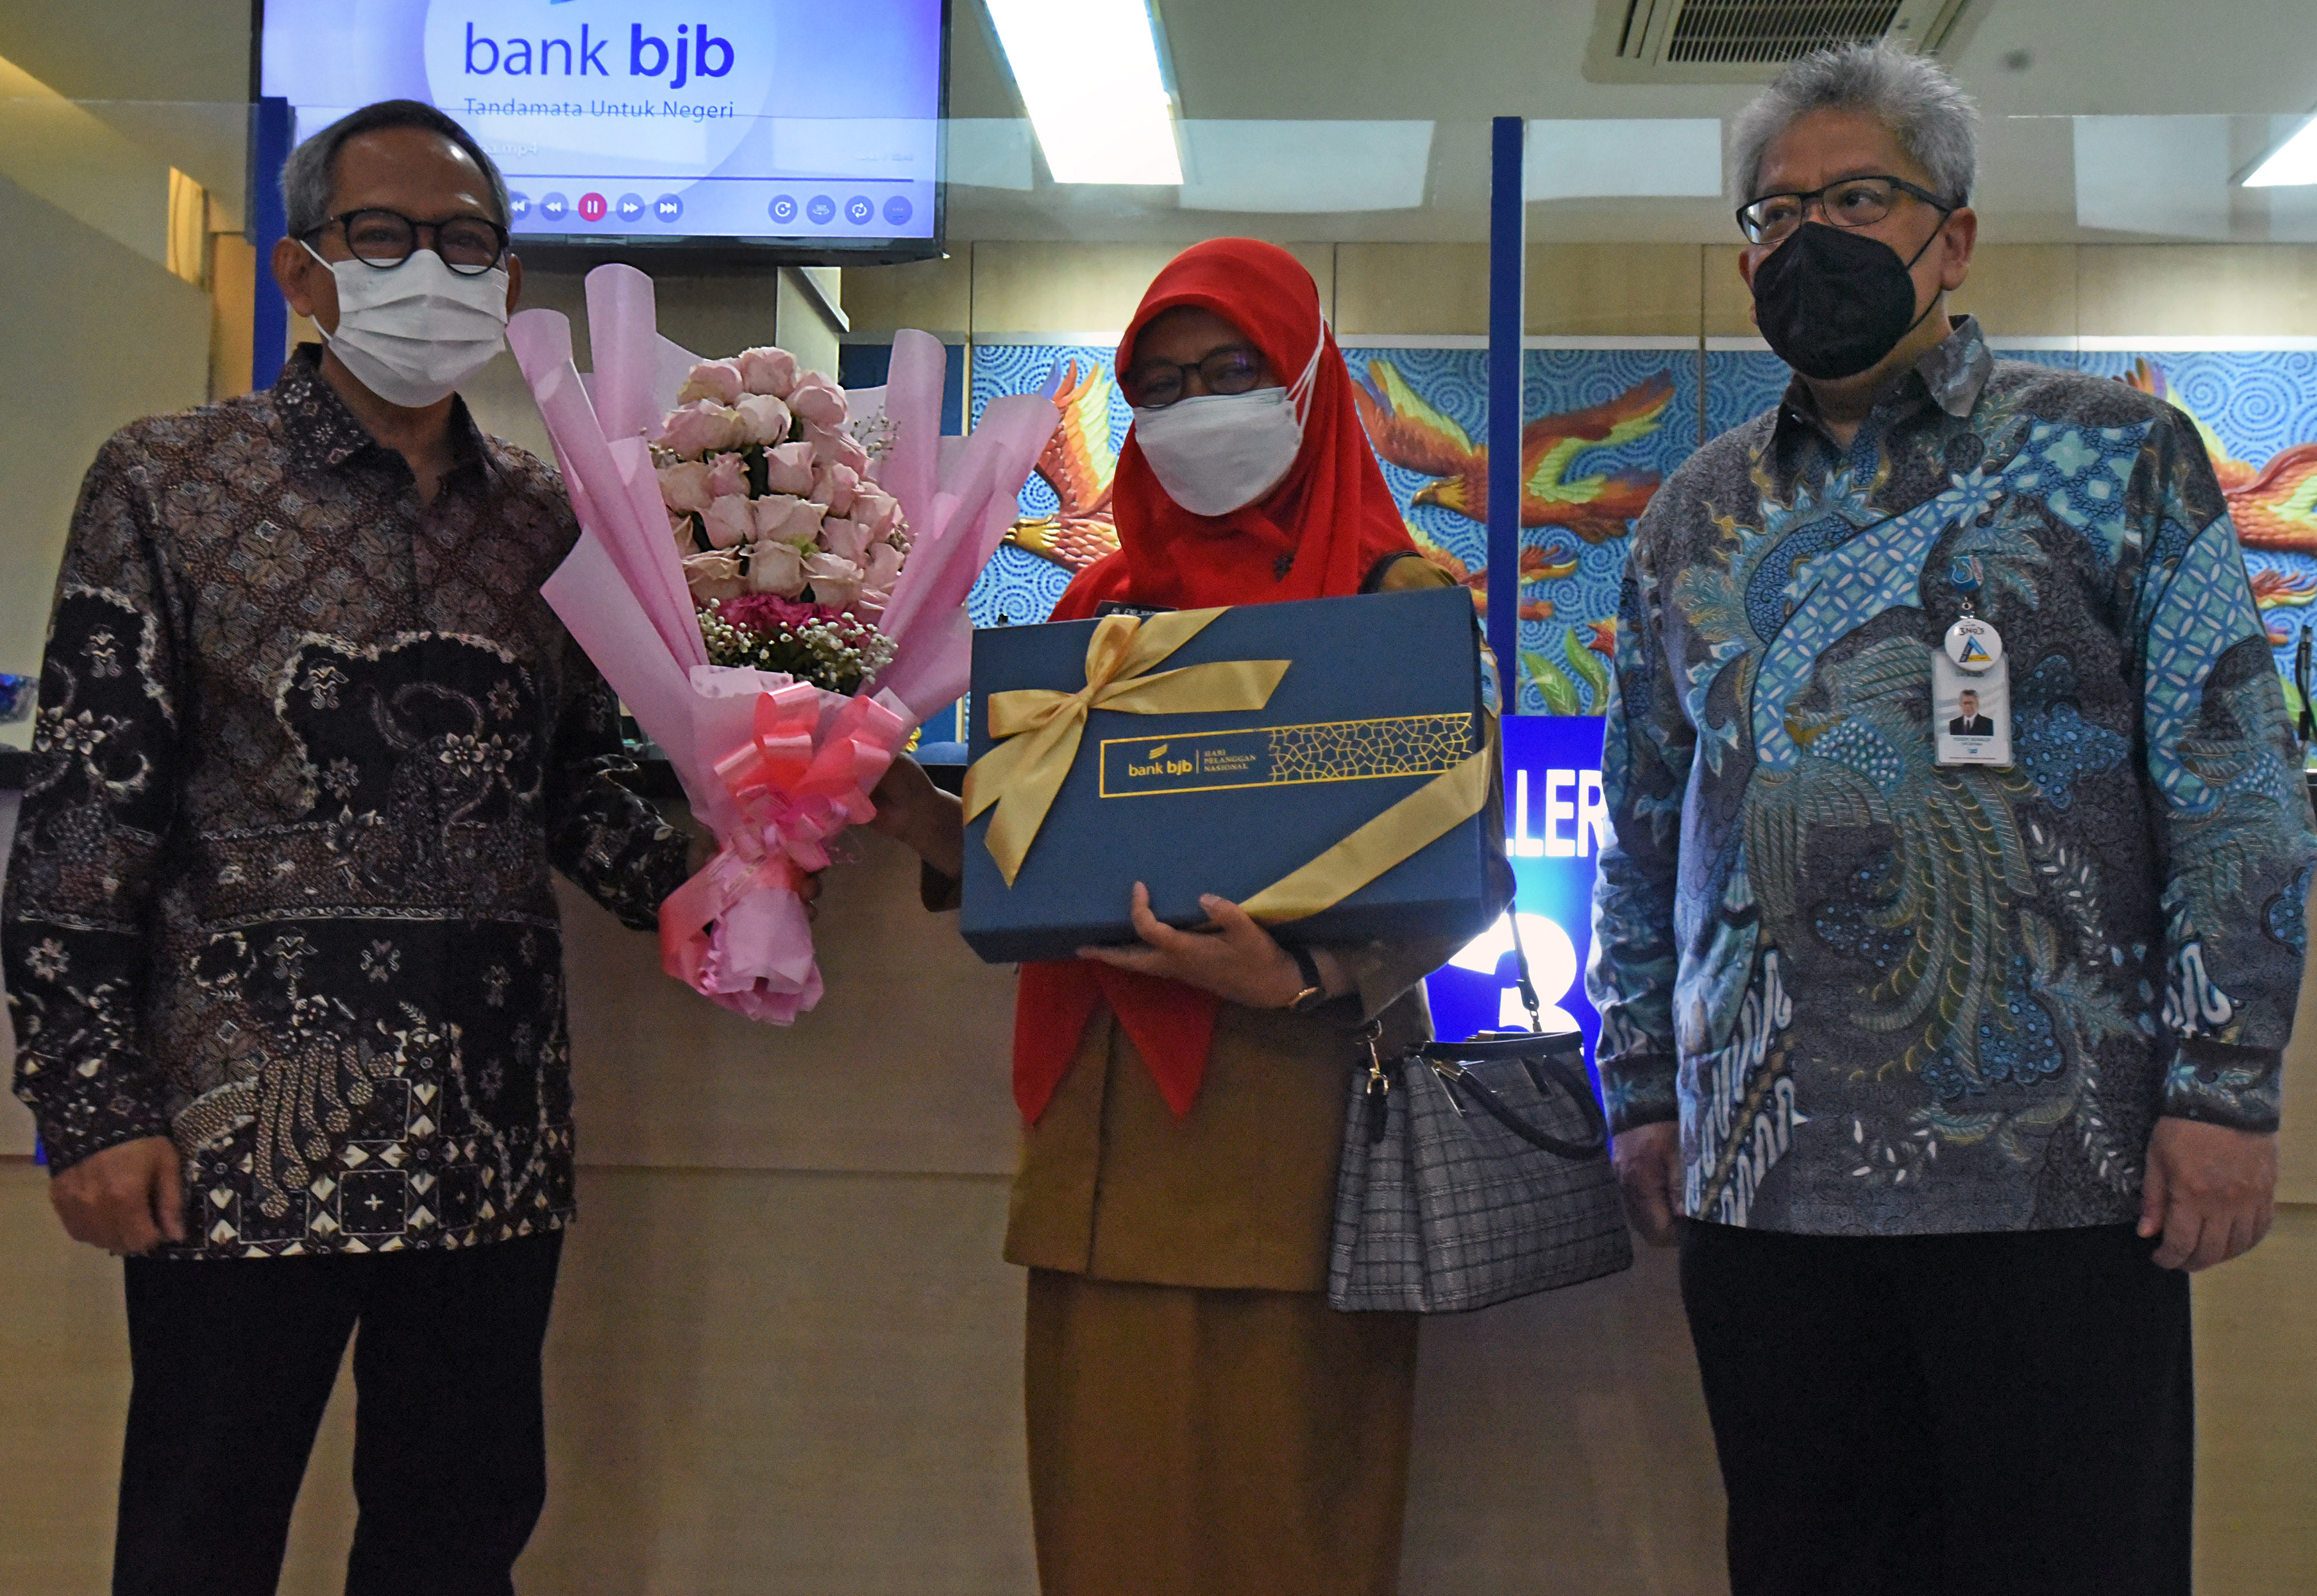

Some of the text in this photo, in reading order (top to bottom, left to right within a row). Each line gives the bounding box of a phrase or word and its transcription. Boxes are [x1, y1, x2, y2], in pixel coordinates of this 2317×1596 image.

[465, 21, 734, 89] bank bjb
[464, 98, 734, 123] Tandamata Untuk Negeri
[1129, 759, 1193, 776] bank bjb
[1506, 769, 1609, 857] LER
